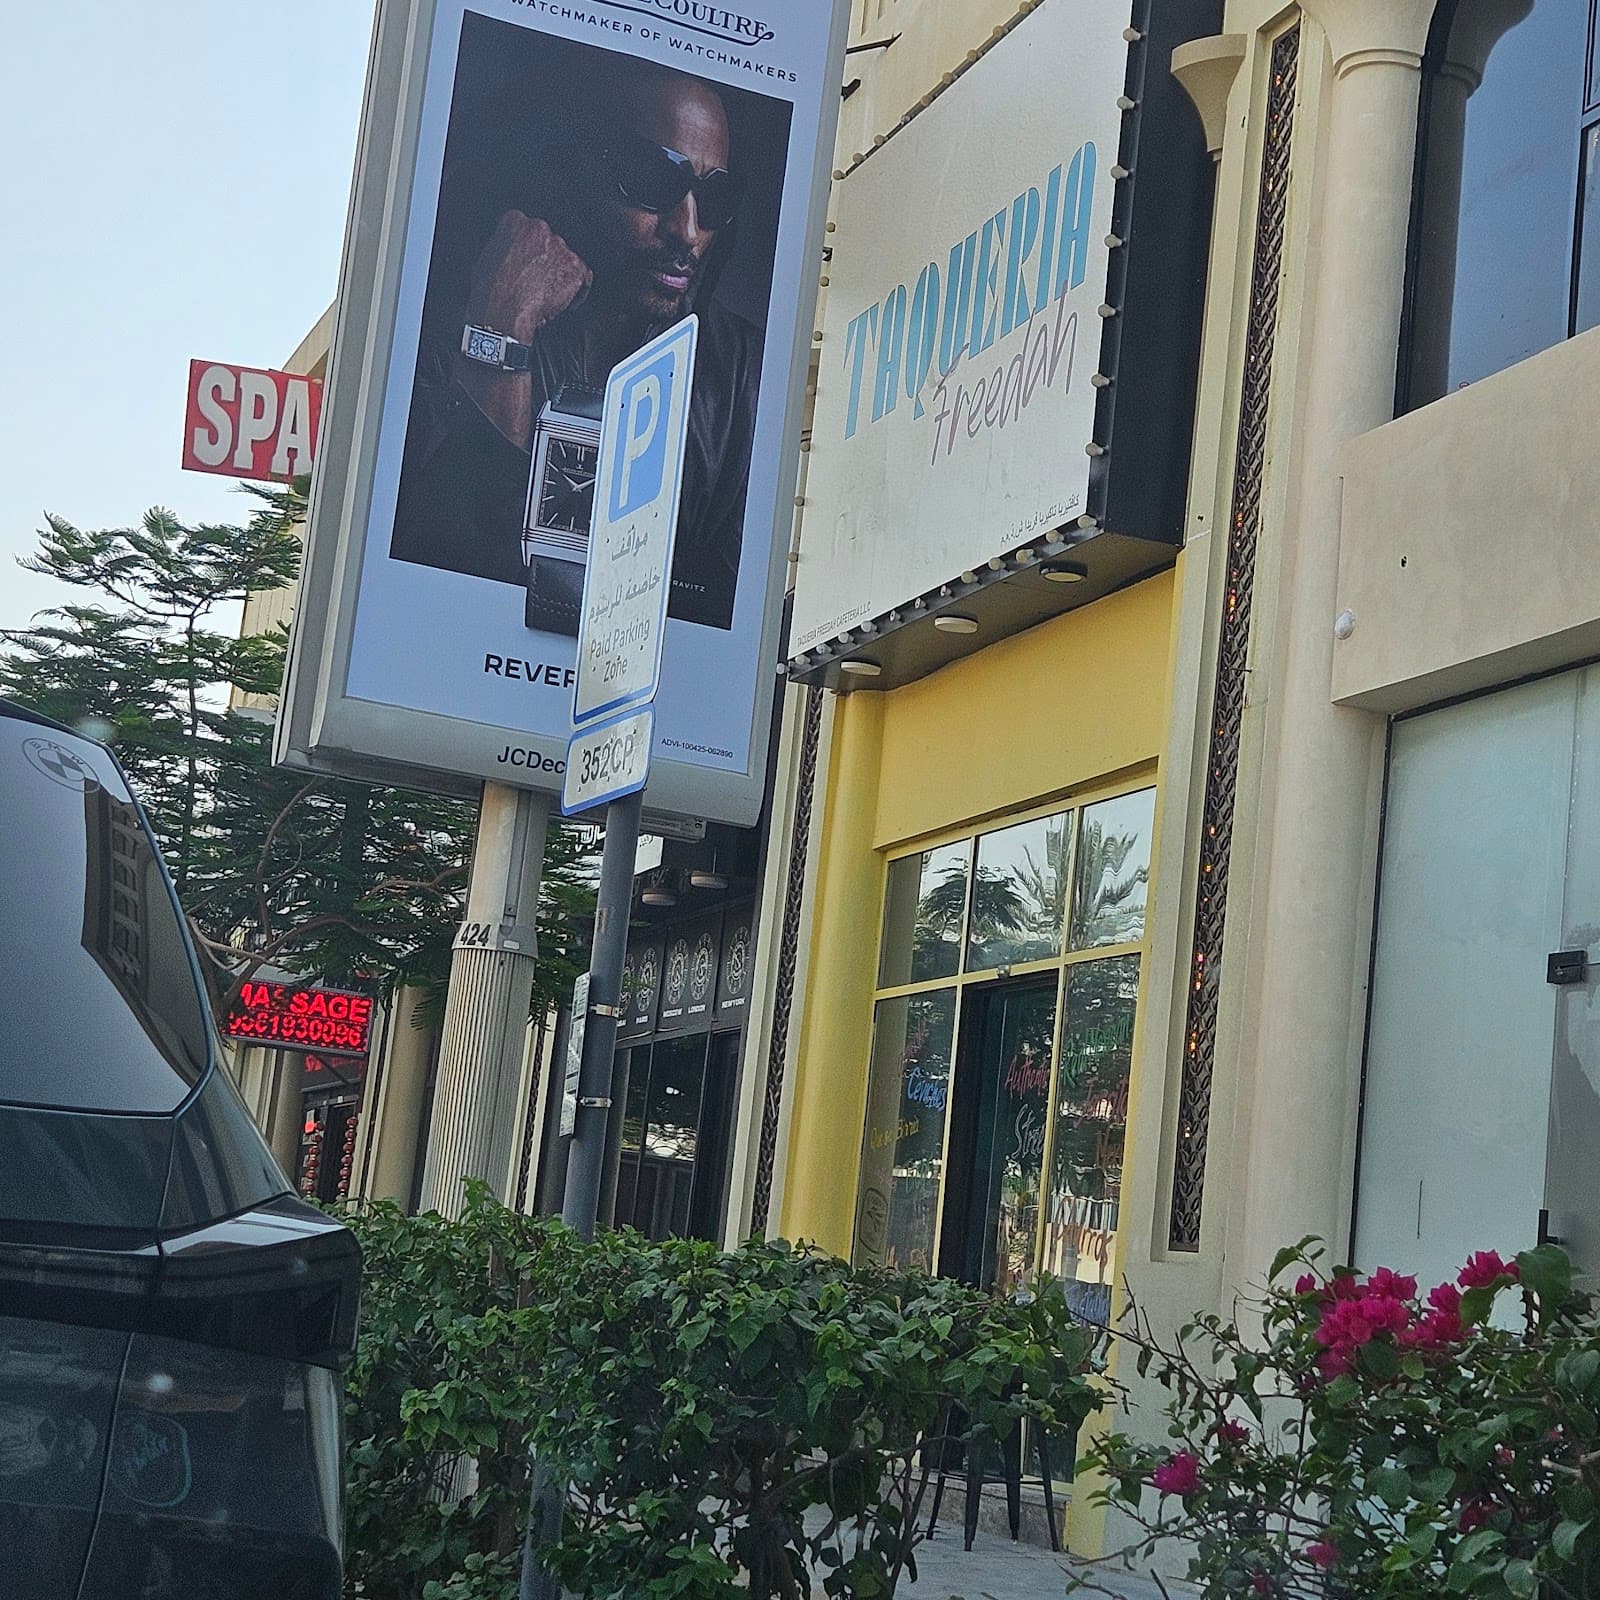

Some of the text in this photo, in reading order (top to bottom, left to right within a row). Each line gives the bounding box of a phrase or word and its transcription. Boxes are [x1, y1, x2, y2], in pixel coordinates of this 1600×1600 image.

[640, 0, 775, 41] COULTRE
[640, 28, 661, 41] OF
[669, 37, 797, 82] WATCHMAKERS
[843, 141, 1097, 440] TAQUERIA
[193, 365, 312, 476] SPA
[619, 374, 661, 509] P
[611, 526, 648, 561] مواقف
[590, 617, 650, 661] Paid Parking
[603, 658, 627, 683] Zone
[497, 746, 566, 774] JCDec
[460, 923, 491, 947] 424
